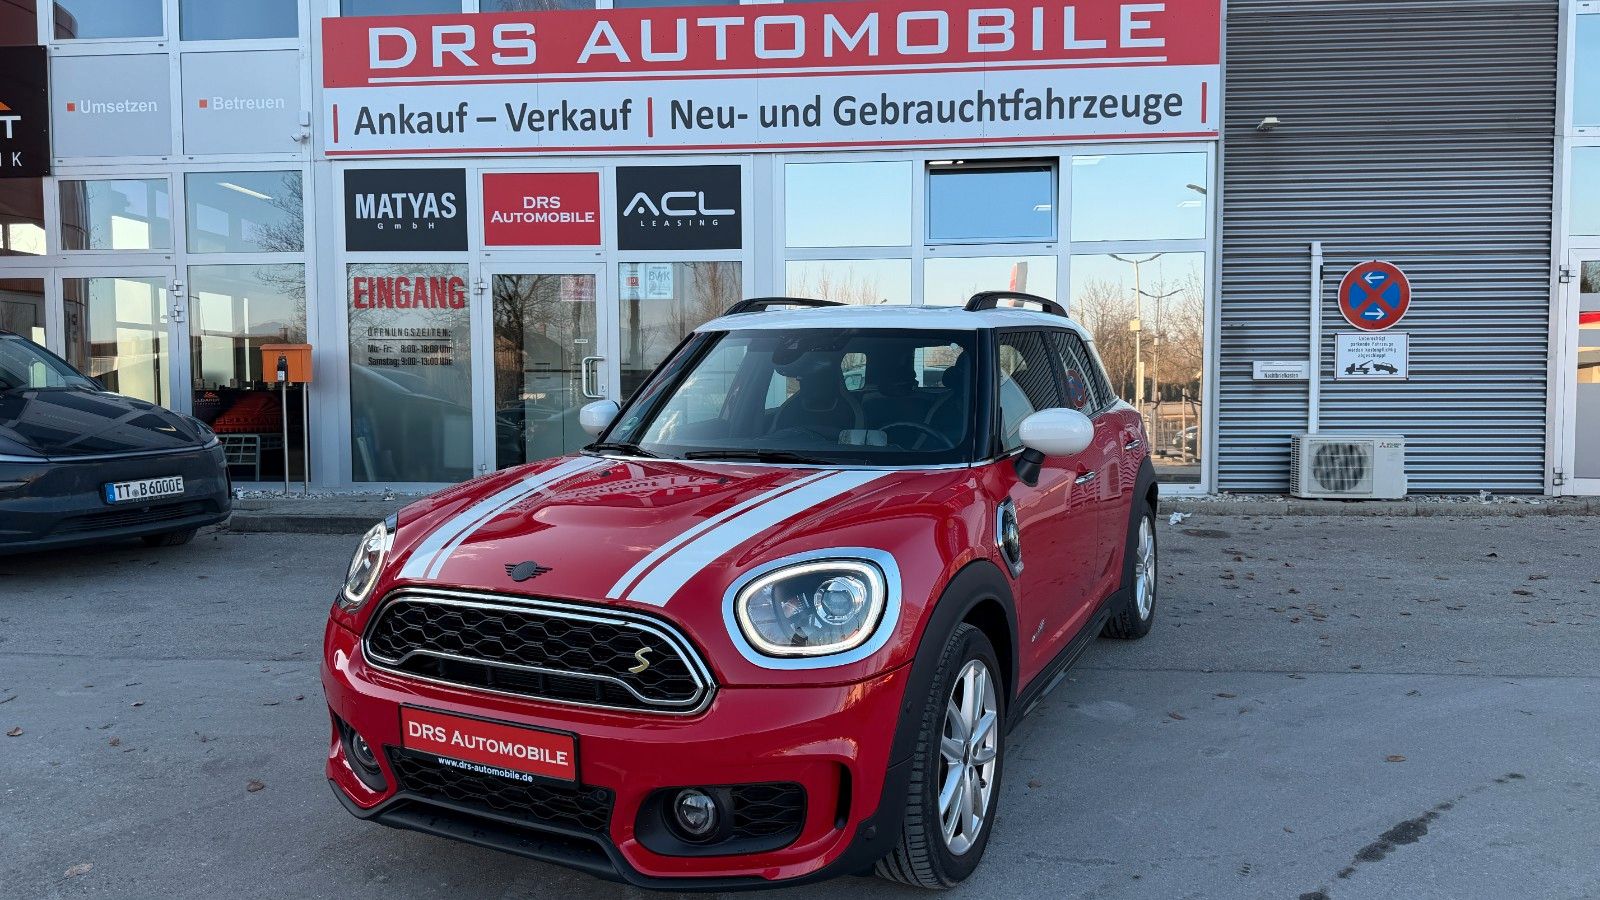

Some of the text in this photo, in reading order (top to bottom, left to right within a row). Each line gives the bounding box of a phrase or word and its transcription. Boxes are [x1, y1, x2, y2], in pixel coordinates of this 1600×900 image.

[368, 2, 1166, 69] DRS AUTOMOBILE
[80, 99, 158, 114] Umsetzen
[212, 96, 285, 111] Betreuen
[353, 101, 468, 136] Ankauf
[504, 98, 632, 133] Verkauf
[670, 99, 748, 130] Neu-
[759, 94, 821, 129] und
[833, 87, 1183, 127] Gebrauchtfahrzeuge
[355, 192, 457, 219] MATYAS
[523, 195, 561, 209] DRS
[622, 190, 736, 217] ACL
[490, 210, 595, 223] AUTOMOBILE
[640, 219, 719, 227] LEASING
[353, 276, 464, 308] EINGANG
[115, 483, 131, 499] TT
[408, 720, 569, 767] DRS AUTOMOBILE
[437, 756, 534, 783] www.drs-automobile.de
